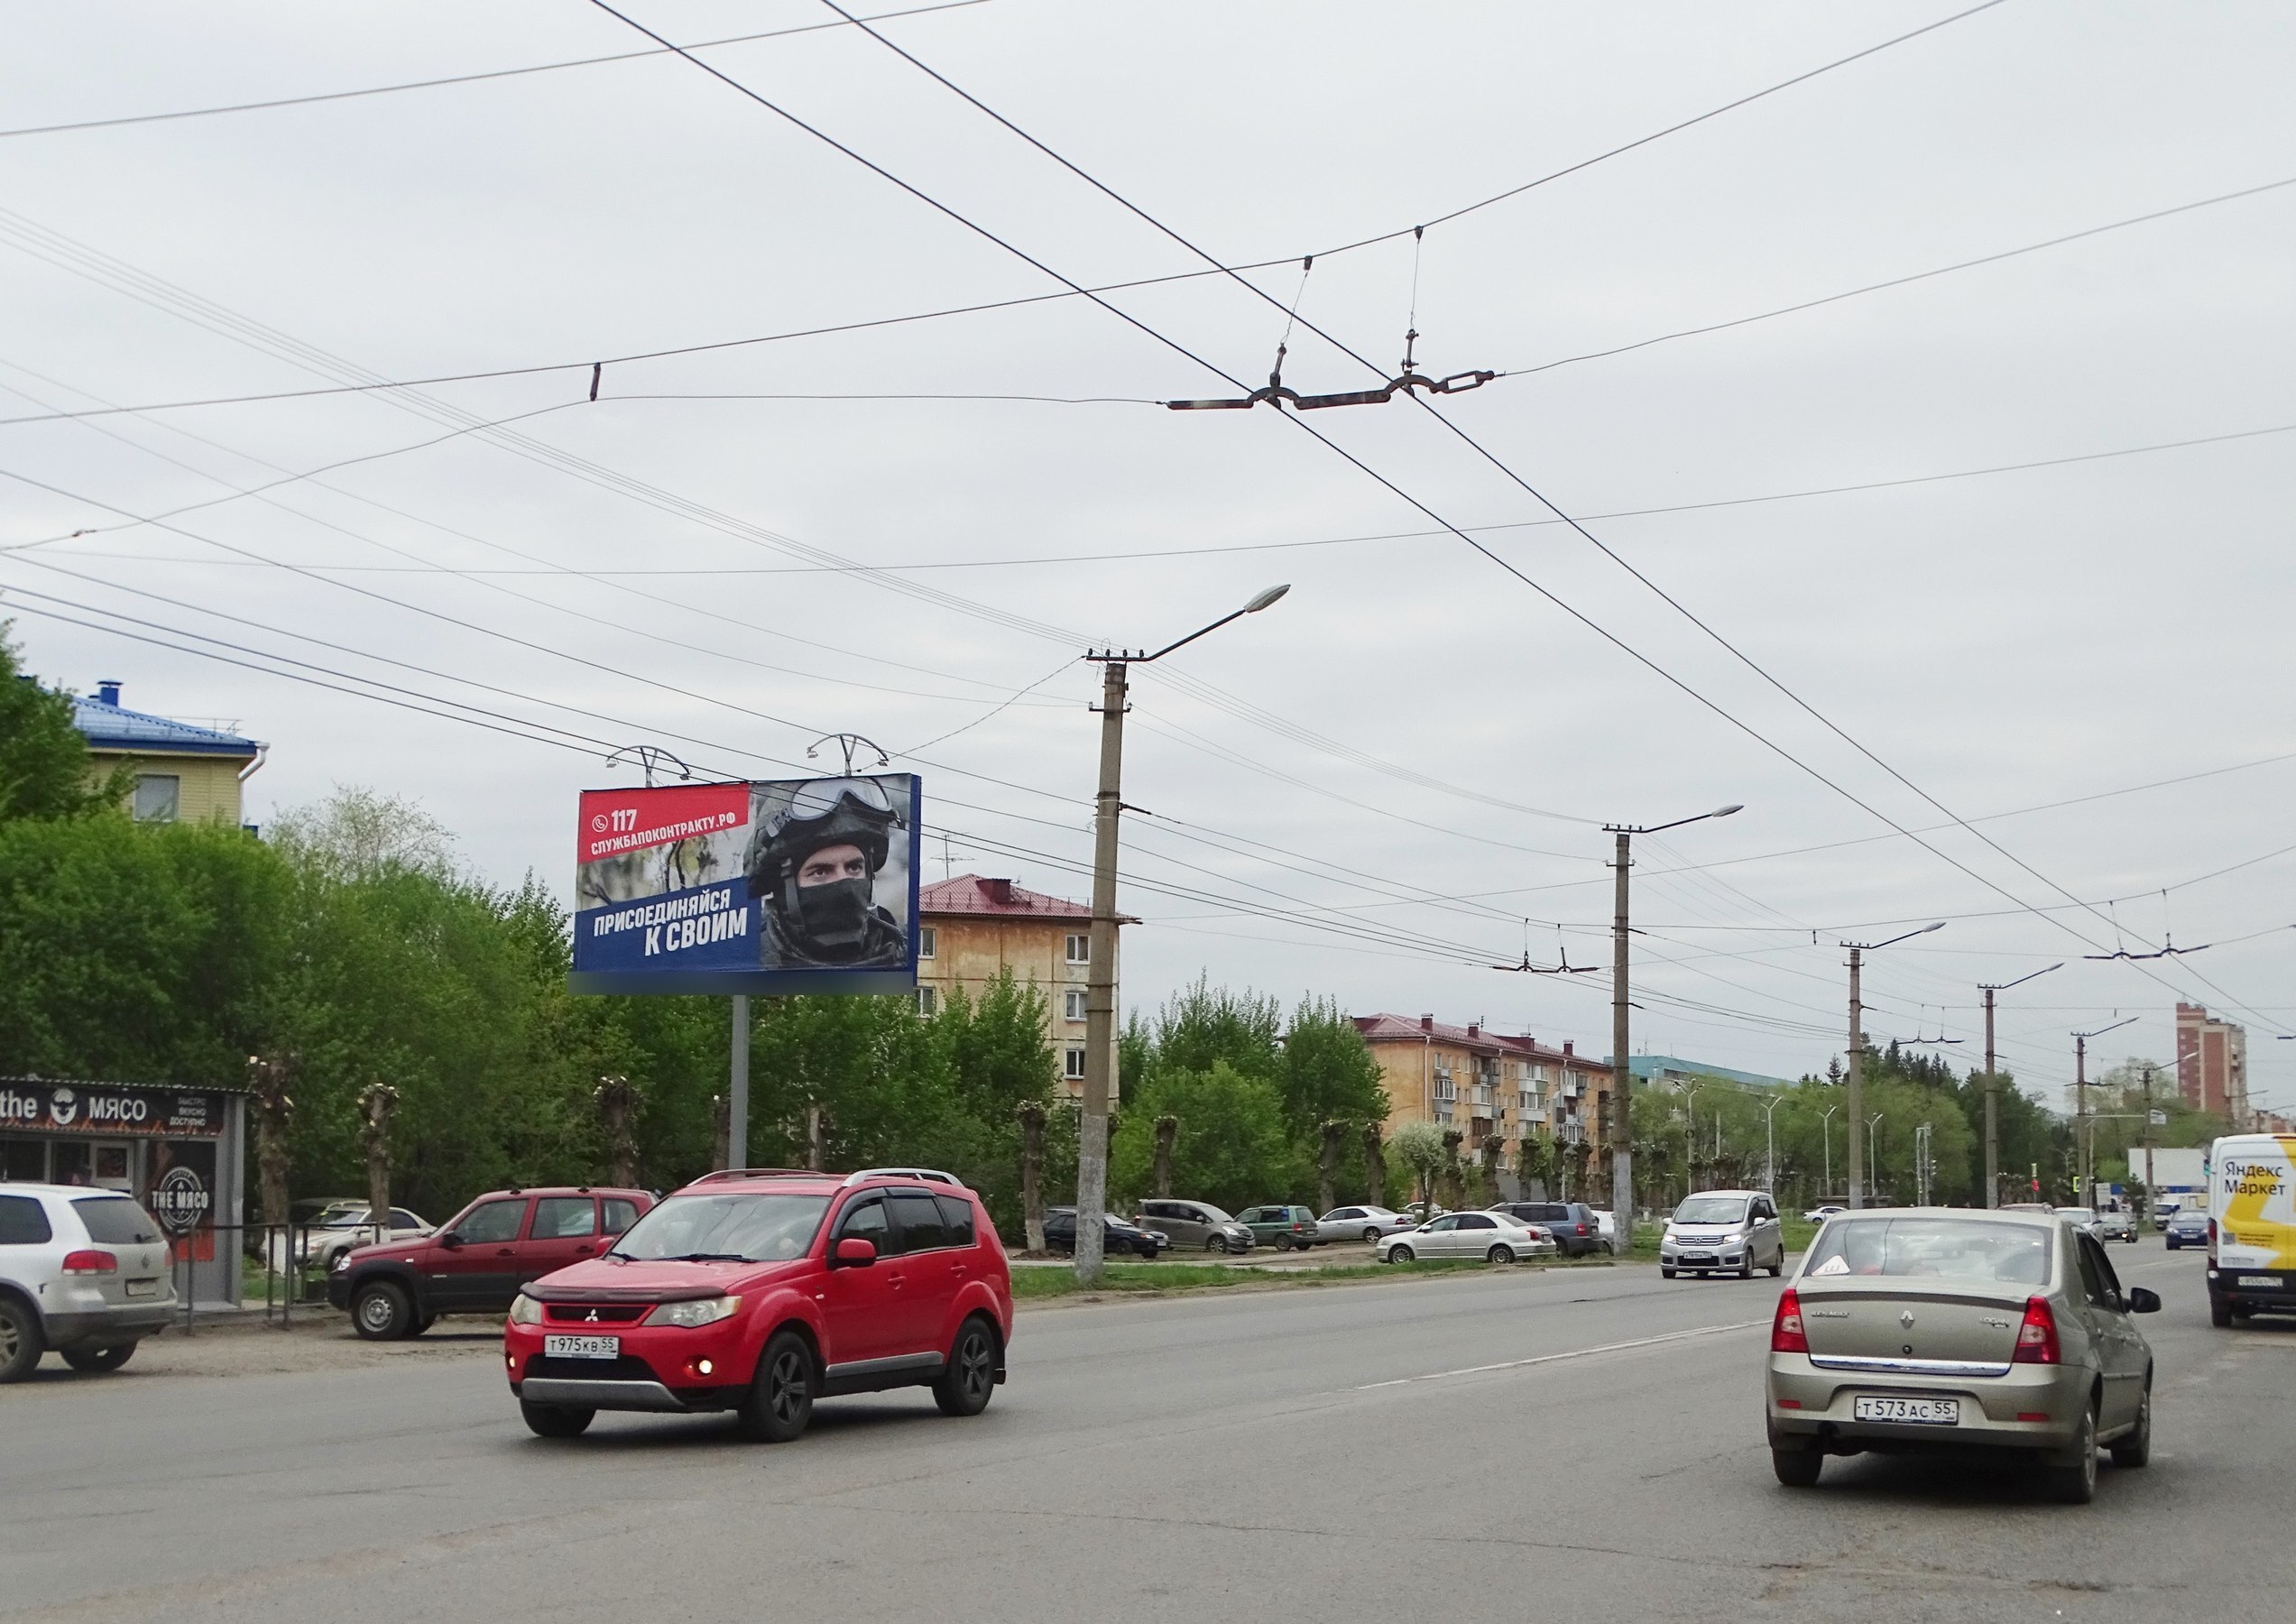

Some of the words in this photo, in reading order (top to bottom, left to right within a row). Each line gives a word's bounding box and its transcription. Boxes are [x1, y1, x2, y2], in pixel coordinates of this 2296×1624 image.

[591, 811, 736, 855] СЛУЖБАПОКОНТРАКТУ.РФ
[611, 808, 638, 832] 117
[594, 889, 731, 937] ПРИСОЕДИНЯЙСЯ
[644, 926, 662, 956] К
[666, 907, 748, 952] СВОИМ
[0, 1089, 38, 1119] the
[89, 1096, 147, 1121] МЯСО
[2225, 1161, 2283, 1178] Яндекс
[152, 1191, 173, 1209] THE
[177, 1191, 208, 1209] МЯСО
[2225, 1178, 2286, 1196] Маркет
